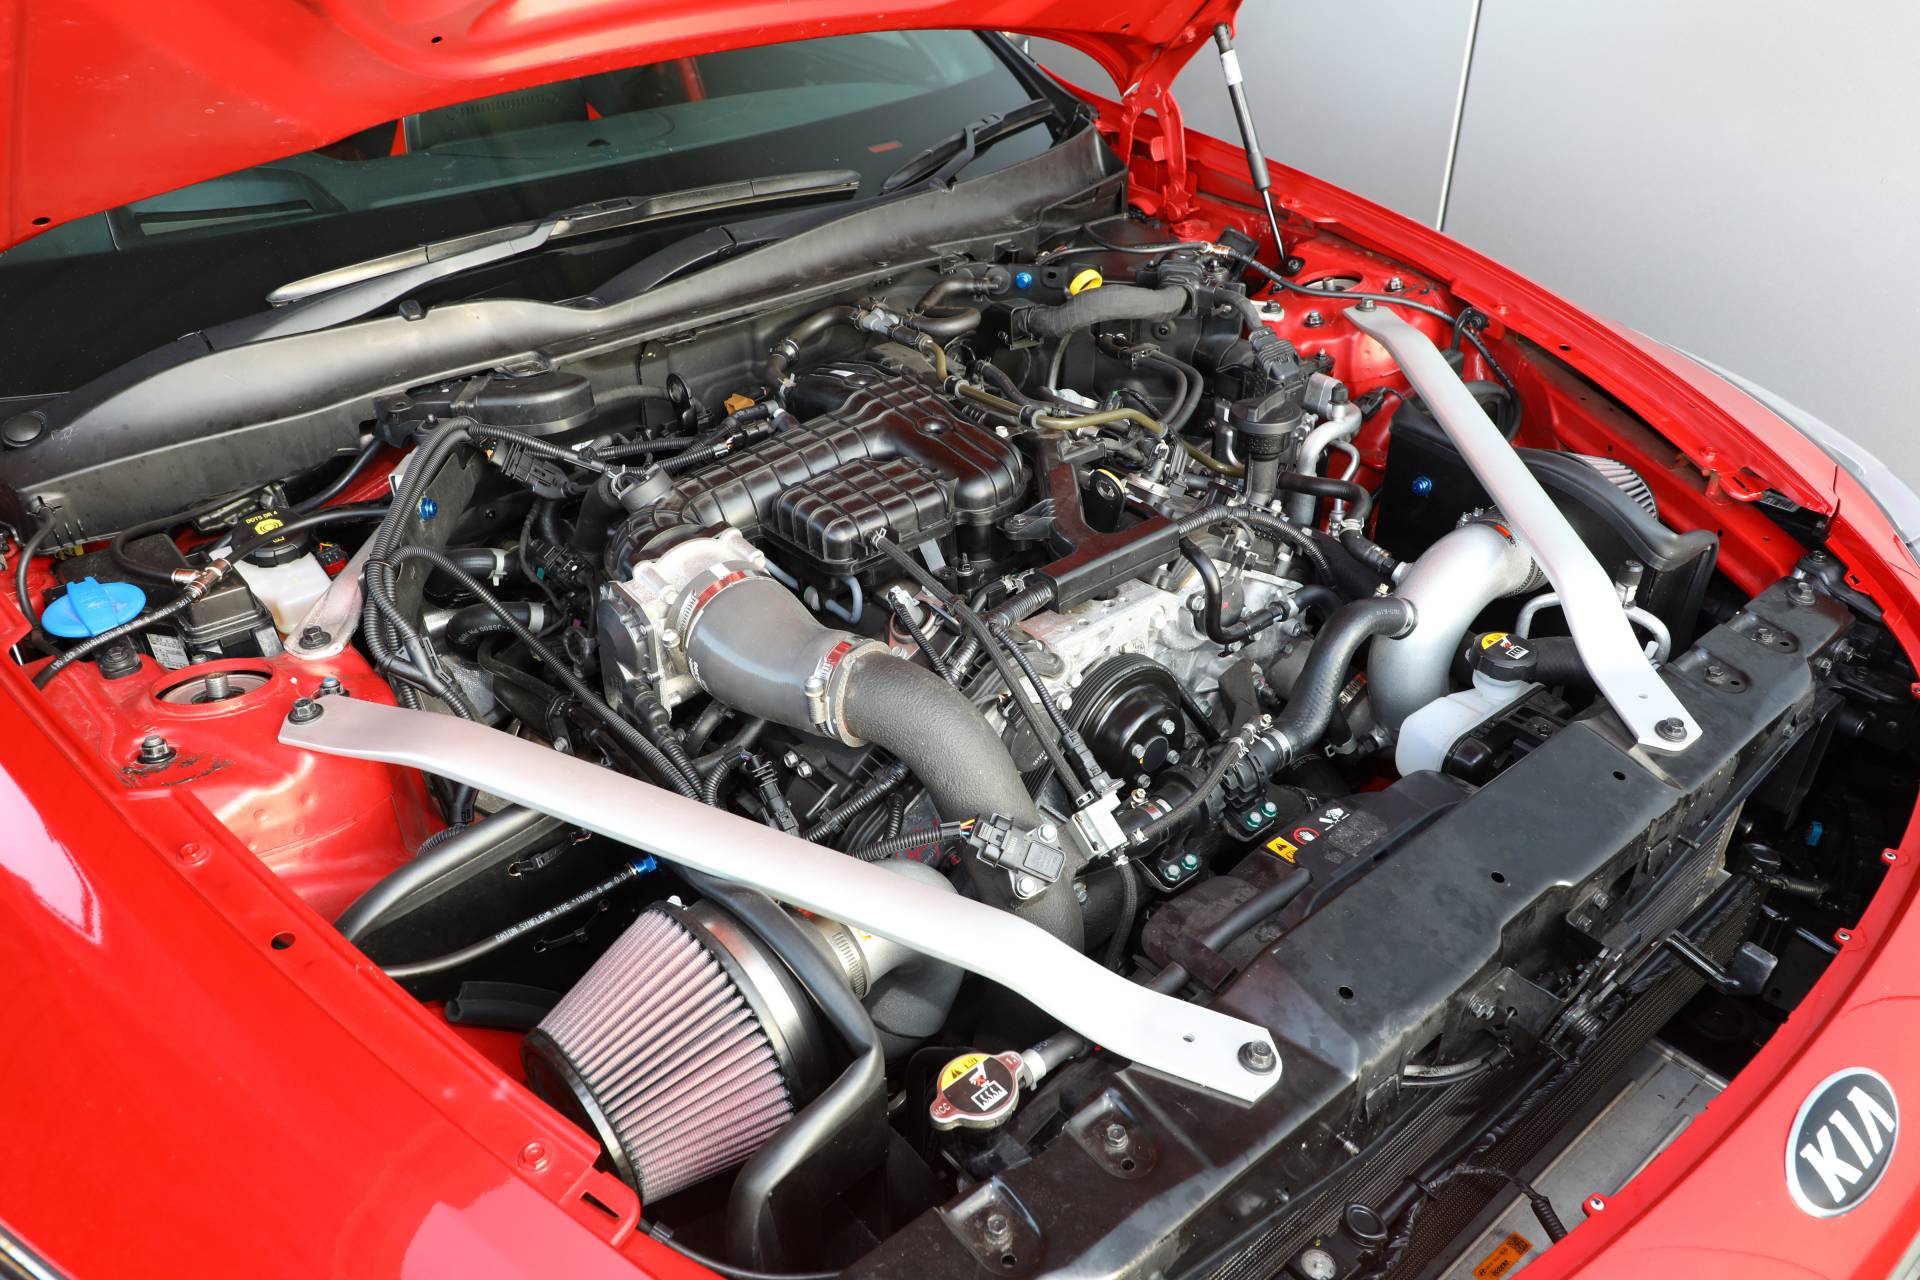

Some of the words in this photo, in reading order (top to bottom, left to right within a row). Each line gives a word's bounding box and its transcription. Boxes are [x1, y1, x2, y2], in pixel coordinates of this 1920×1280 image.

[176, 597, 193, 609] TYPE
[552, 902, 571, 915] TYPE
[1800, 1085, 1896, 1203] KIA
